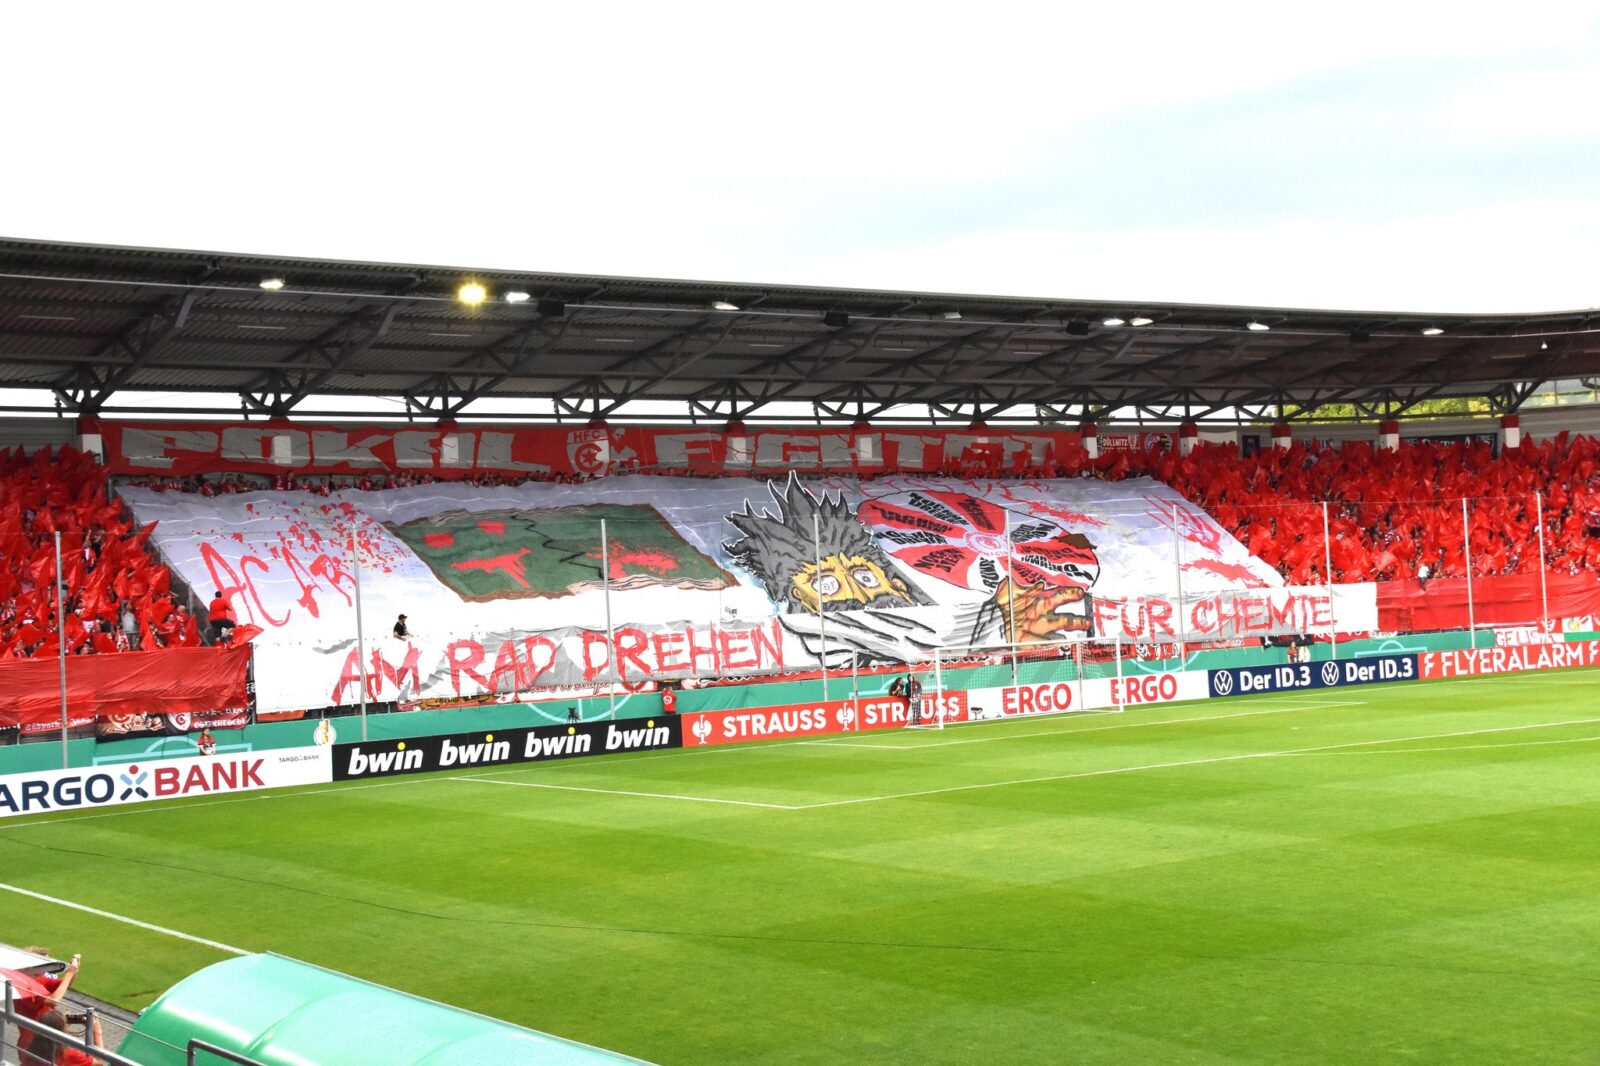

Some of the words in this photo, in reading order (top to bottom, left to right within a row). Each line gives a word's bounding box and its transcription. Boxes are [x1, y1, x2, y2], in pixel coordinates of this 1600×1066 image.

[331, 642, 420, 708] AM
[447, 635, 556, 700] RAD
[580, 618, 785, 683] DREHEN
[1092, 597, 1177, 640] FÜR
[1191, 590, 1338, 634] CHEMIE
[1442, 643, 1584, 676] FLYERALARM
[1110, 674, 1178, 704] ERGO
[1240, 671, 1271, 692] Der
[1276, 667, 1311, 687] ID.3
[1346, 664, 1375, 682] Der
[1380, 658, 1413, 678] ID.3
[1002, 683, 1072, 714] ERGO
[605, 718, 670, 751] bwin
[723, 708, 826, 738] STRAUSS
[348, 742, 422, 775] bwin
[439, 734, 510, 767] bwin
[524, 726, 591, 759] bwin
[155, 759, 265, 796] BANK
